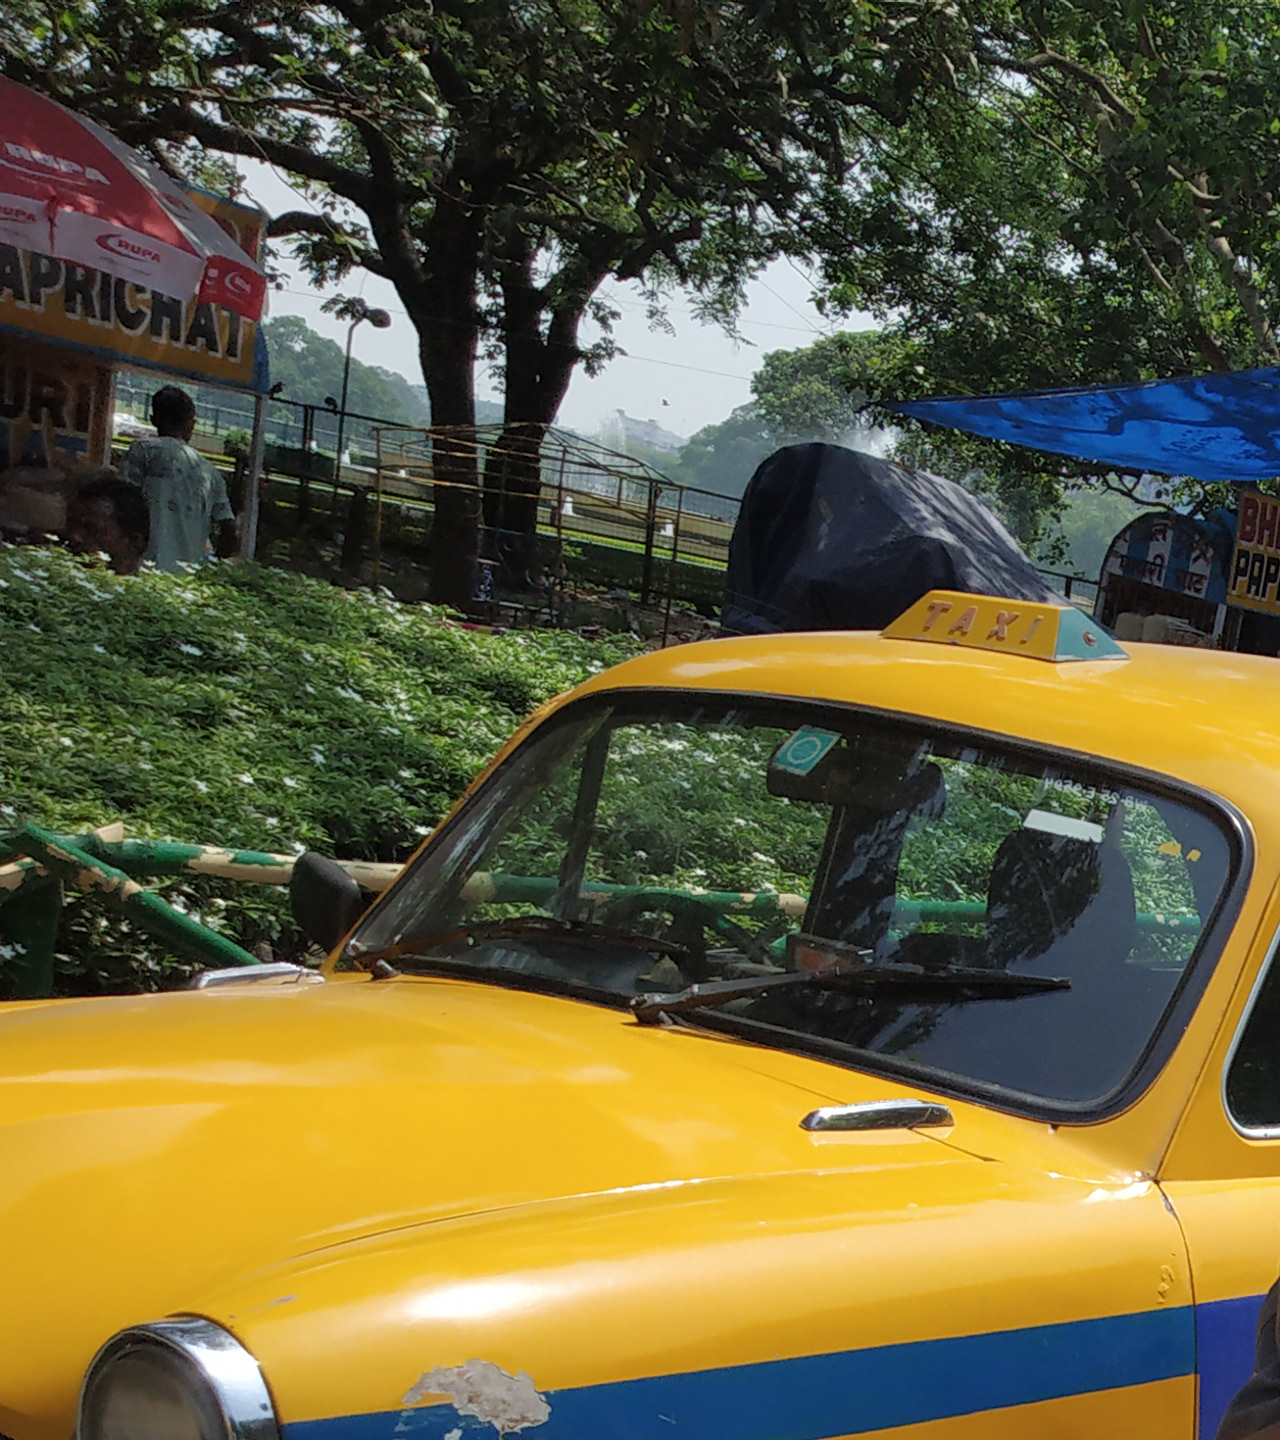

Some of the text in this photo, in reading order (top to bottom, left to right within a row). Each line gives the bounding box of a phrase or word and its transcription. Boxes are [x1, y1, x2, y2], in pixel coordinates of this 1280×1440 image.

[4, 142, 111, 184] RUPA
[117, 239, 161, 263] RUPA
[922, 600, 1044, 645] TAXI
